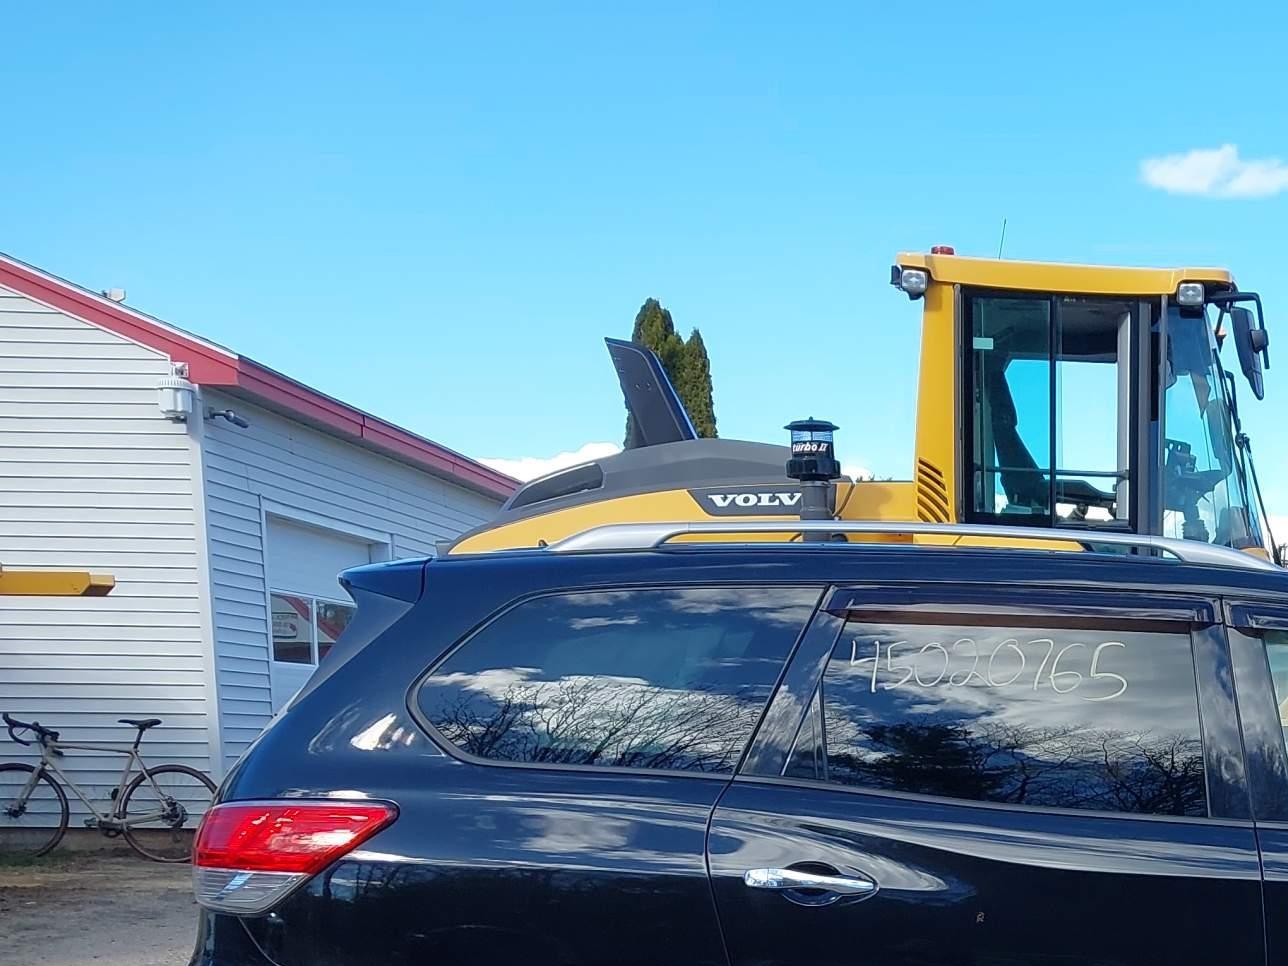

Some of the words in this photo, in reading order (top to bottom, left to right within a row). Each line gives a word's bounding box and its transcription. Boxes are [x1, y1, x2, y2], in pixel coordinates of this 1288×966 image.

[792, 442, 818, 452] turbo
[707, 492, 802, 507] VOLV
[850, 638, 1128, 701] 45020765
